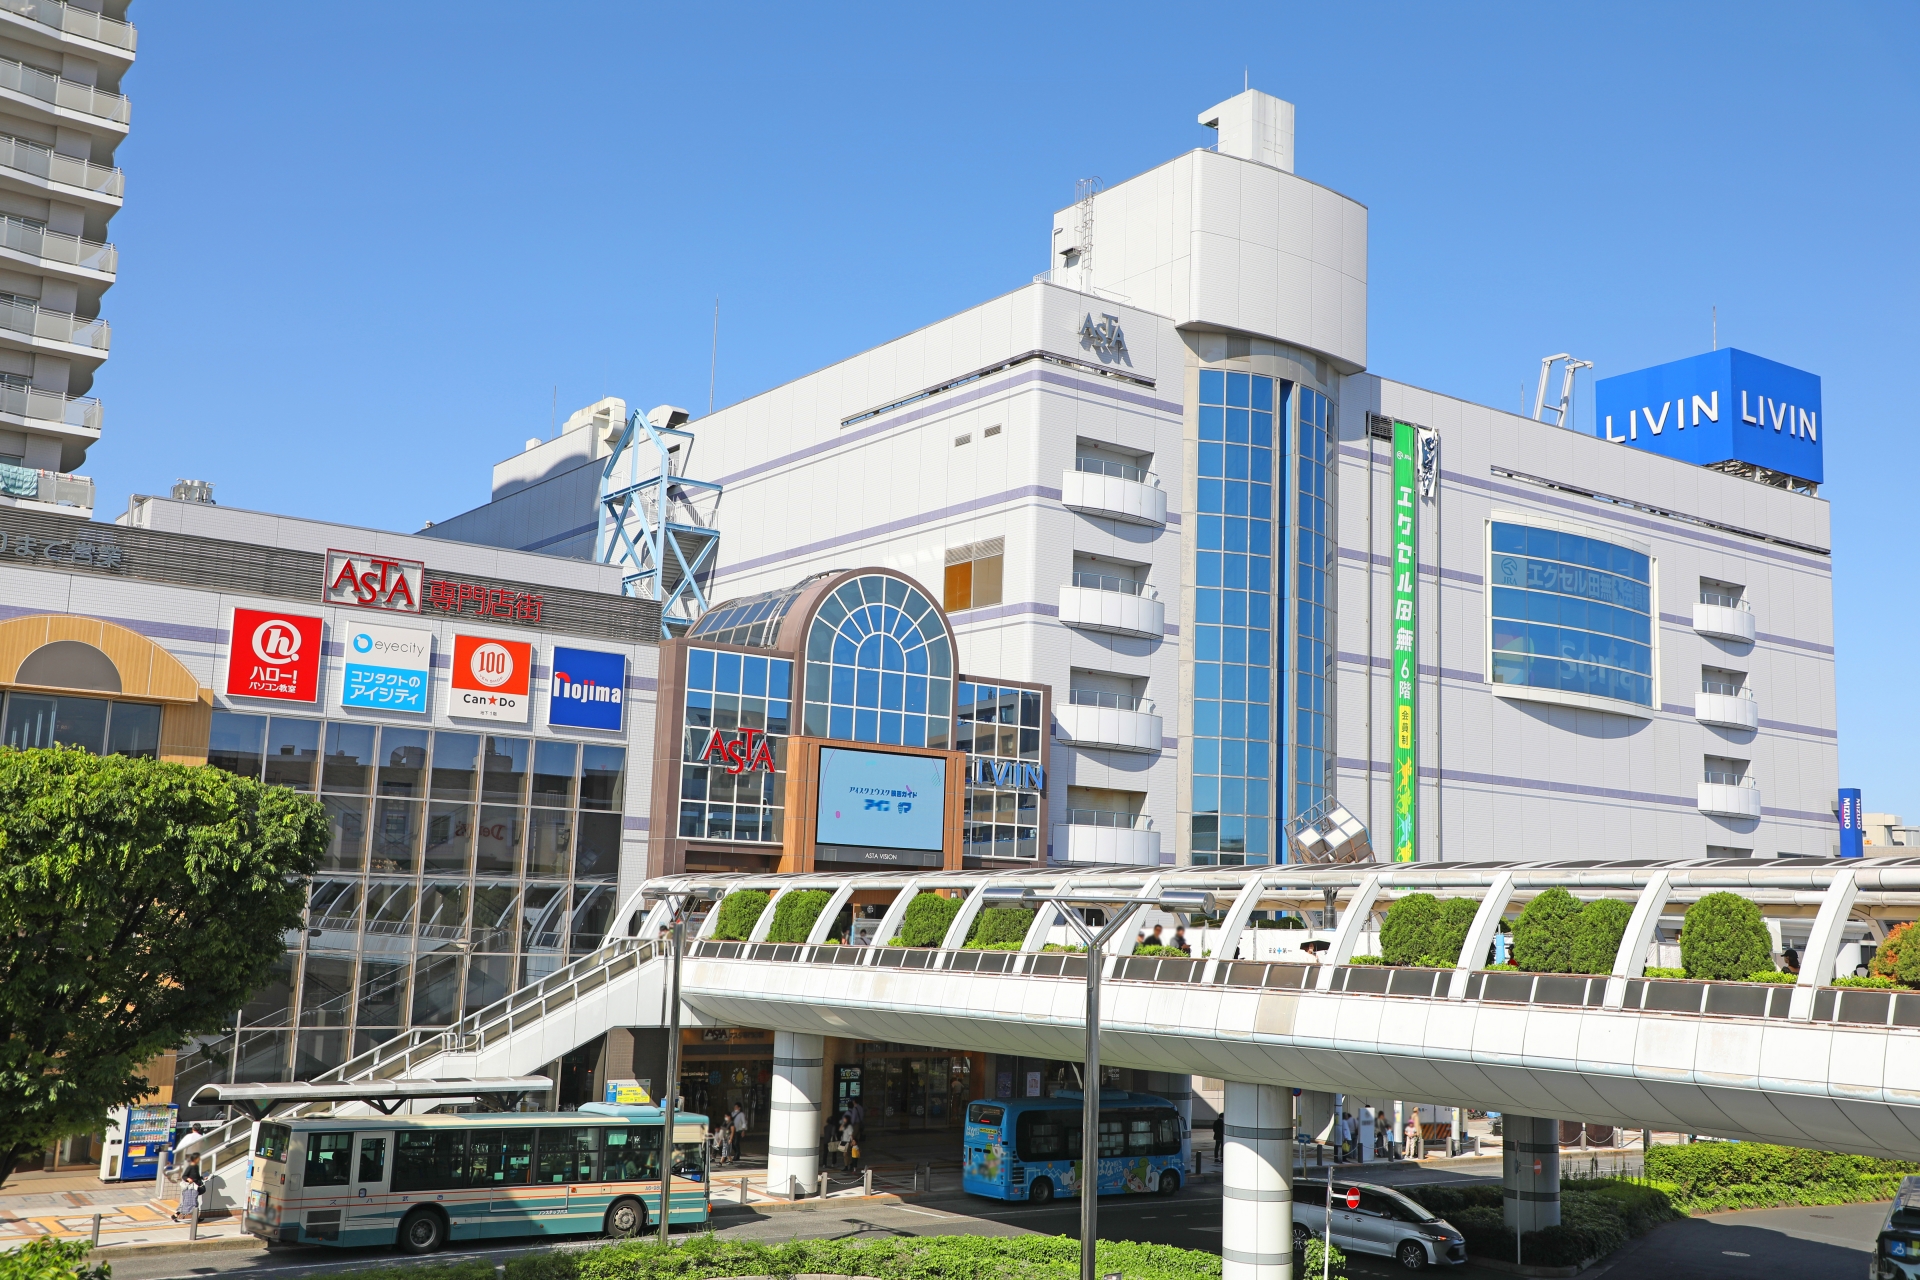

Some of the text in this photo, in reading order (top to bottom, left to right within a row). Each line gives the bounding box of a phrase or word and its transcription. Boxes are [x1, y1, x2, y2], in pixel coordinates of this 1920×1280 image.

[1079, 312, 1128, 351] ASTA
[1605, 390, 1718, 442] LIVIN
[1741, 390, 1816, 442] LIVIN
[331, 558, 415, 606] ASTA
[1501, 576, 1518, 586] JRA
[1528, 563, 1612, 601] エクセル田無
[428, 580, 543, 622] 専門店街
[375, 640, 425, 657] eyecity
[478, 651, 506, 674] 100
[249, 682, 297, 693] パソコン教室
[350, 684, 419, 705] アイシティ
[351, 670, 421, 688] コンタクトの
[553, 671, 621, 704] nojima
[1399, 659, 1411, 699] 6階
[1401, 710, 1409, 745] 会員制
[702, 727, 776, 774] ASTA
[977, 759, 1043, 790] IVIN
[1843, 797, 1851, 829] MIZUHO
